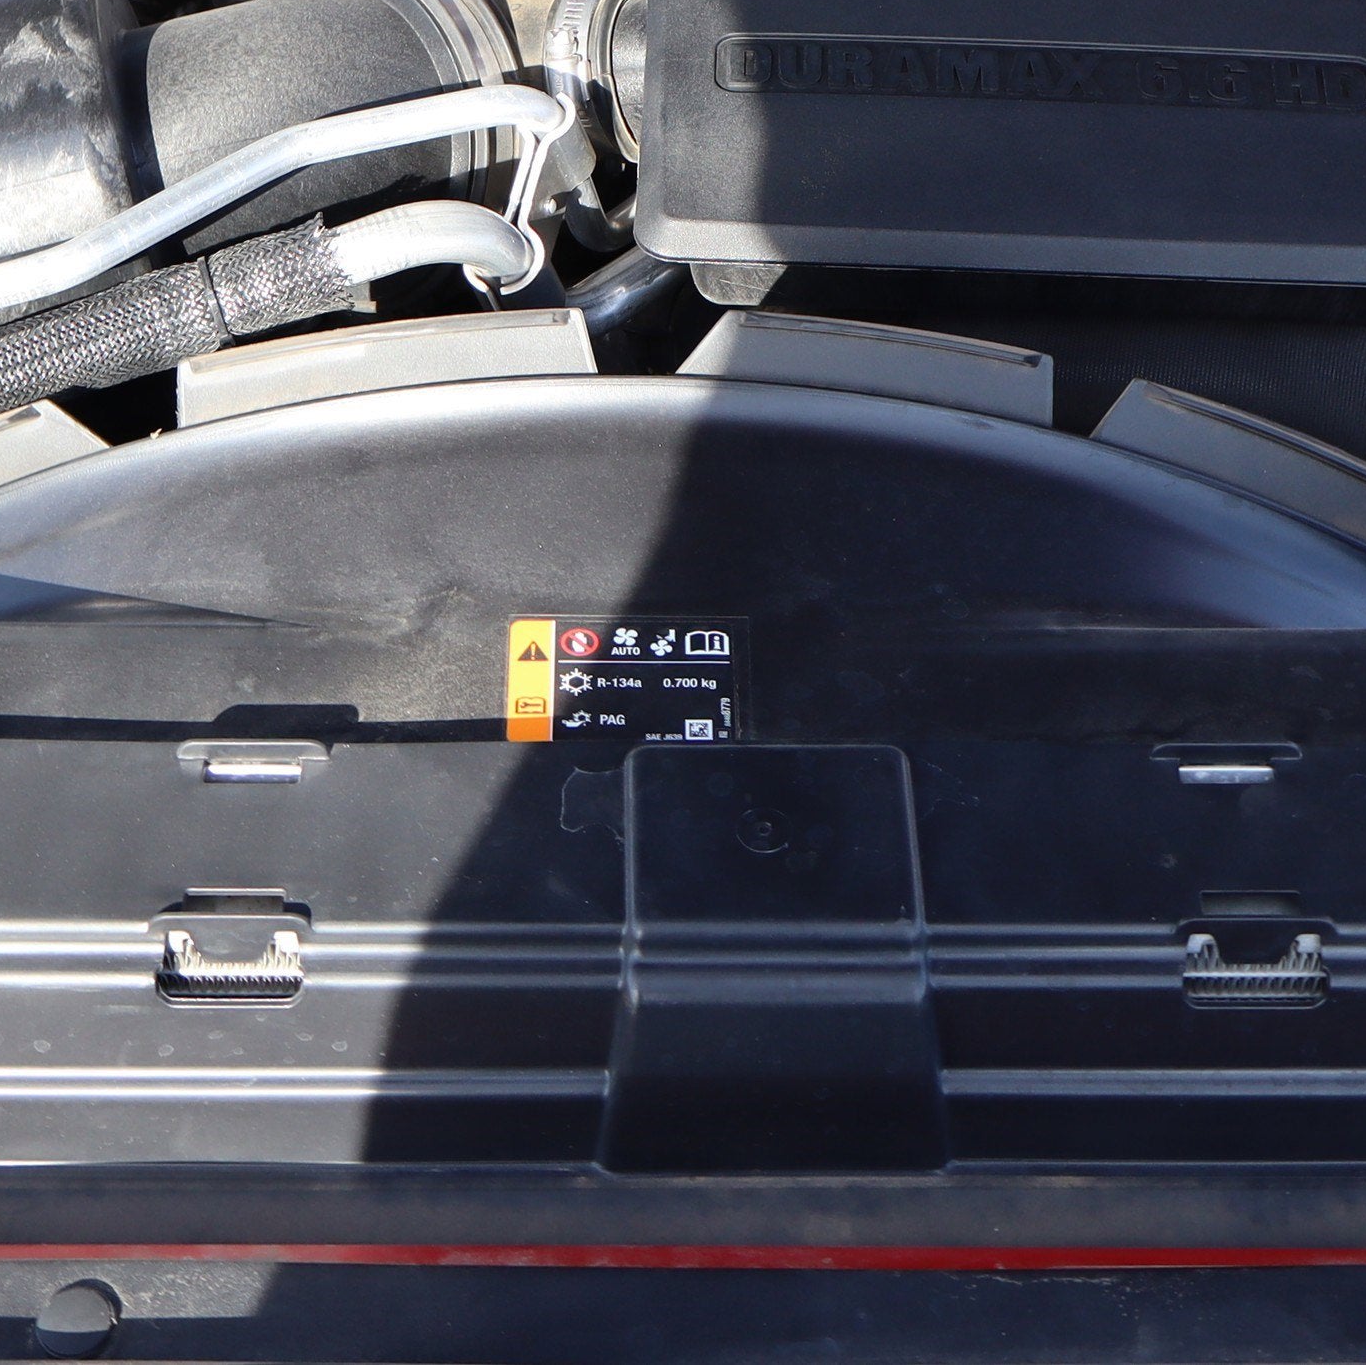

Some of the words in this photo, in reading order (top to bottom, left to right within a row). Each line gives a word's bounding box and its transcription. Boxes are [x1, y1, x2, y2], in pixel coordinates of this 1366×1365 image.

[730, 41, 1103, 98] DURAMAX
[1135, 55, 1254, 103] 6.6
[611, 646, 641, 656] AUTO
[597, 677, 642, 688] R-134a
[663, 677, 698, 688] 0.700
[701, 677, 717, 690] kg
[599, 714, 626, 725] PAG
